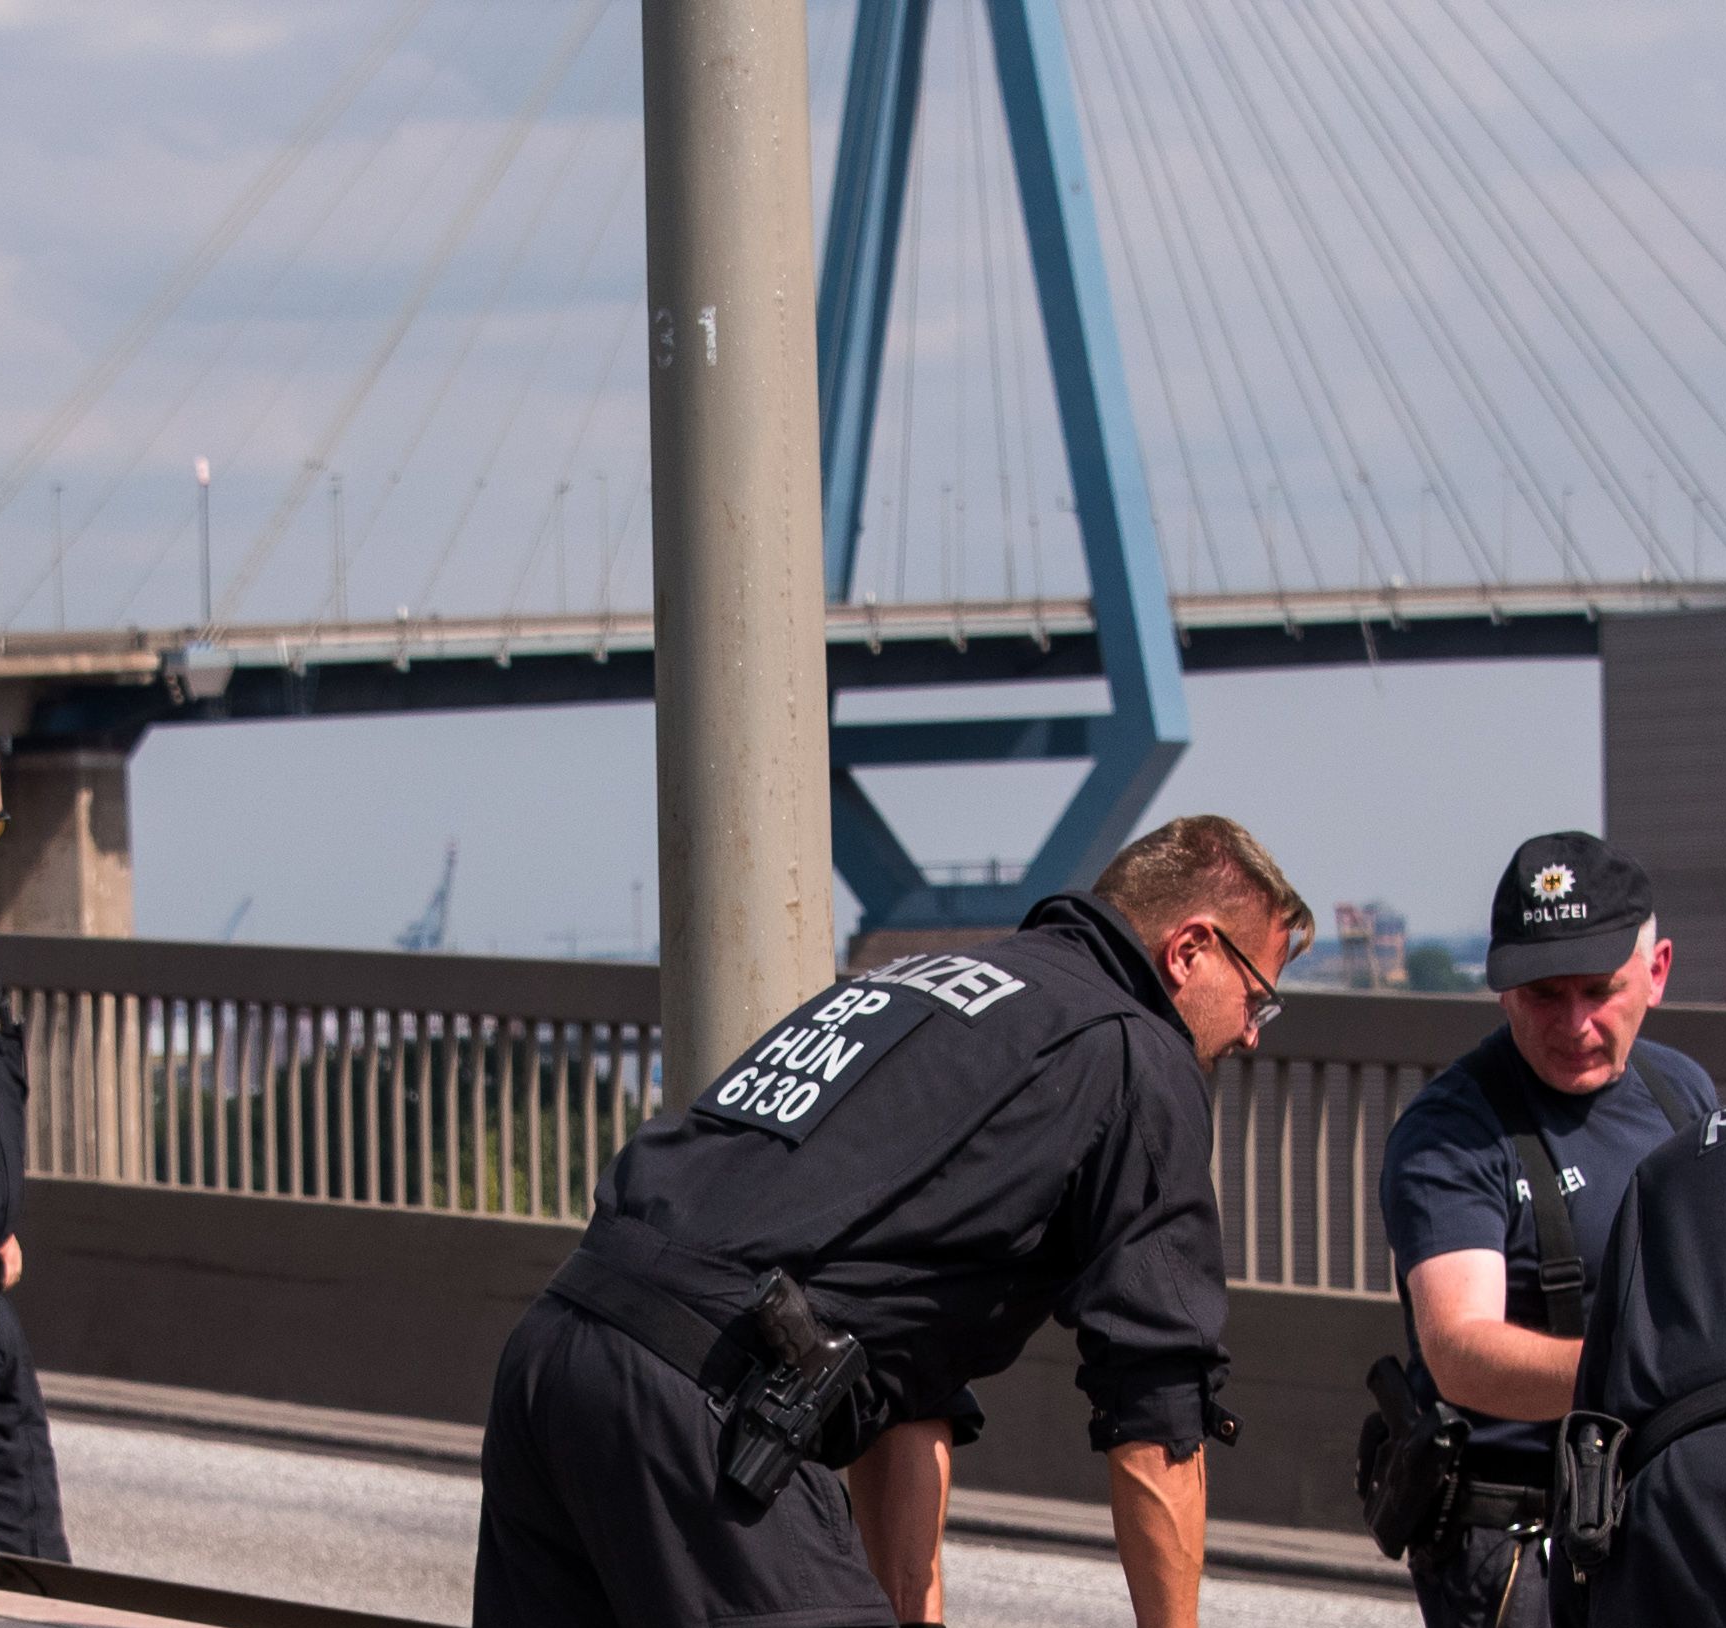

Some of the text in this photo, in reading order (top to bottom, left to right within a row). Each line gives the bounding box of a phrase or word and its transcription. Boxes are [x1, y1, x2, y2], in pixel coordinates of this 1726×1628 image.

[1523, 903, 1587, 926] POLIZEI
[812, 987, 891, 1025] BP
[755, 1023, 864, 1082] HÜN
[717, 1067, 820, 1123] 6130
